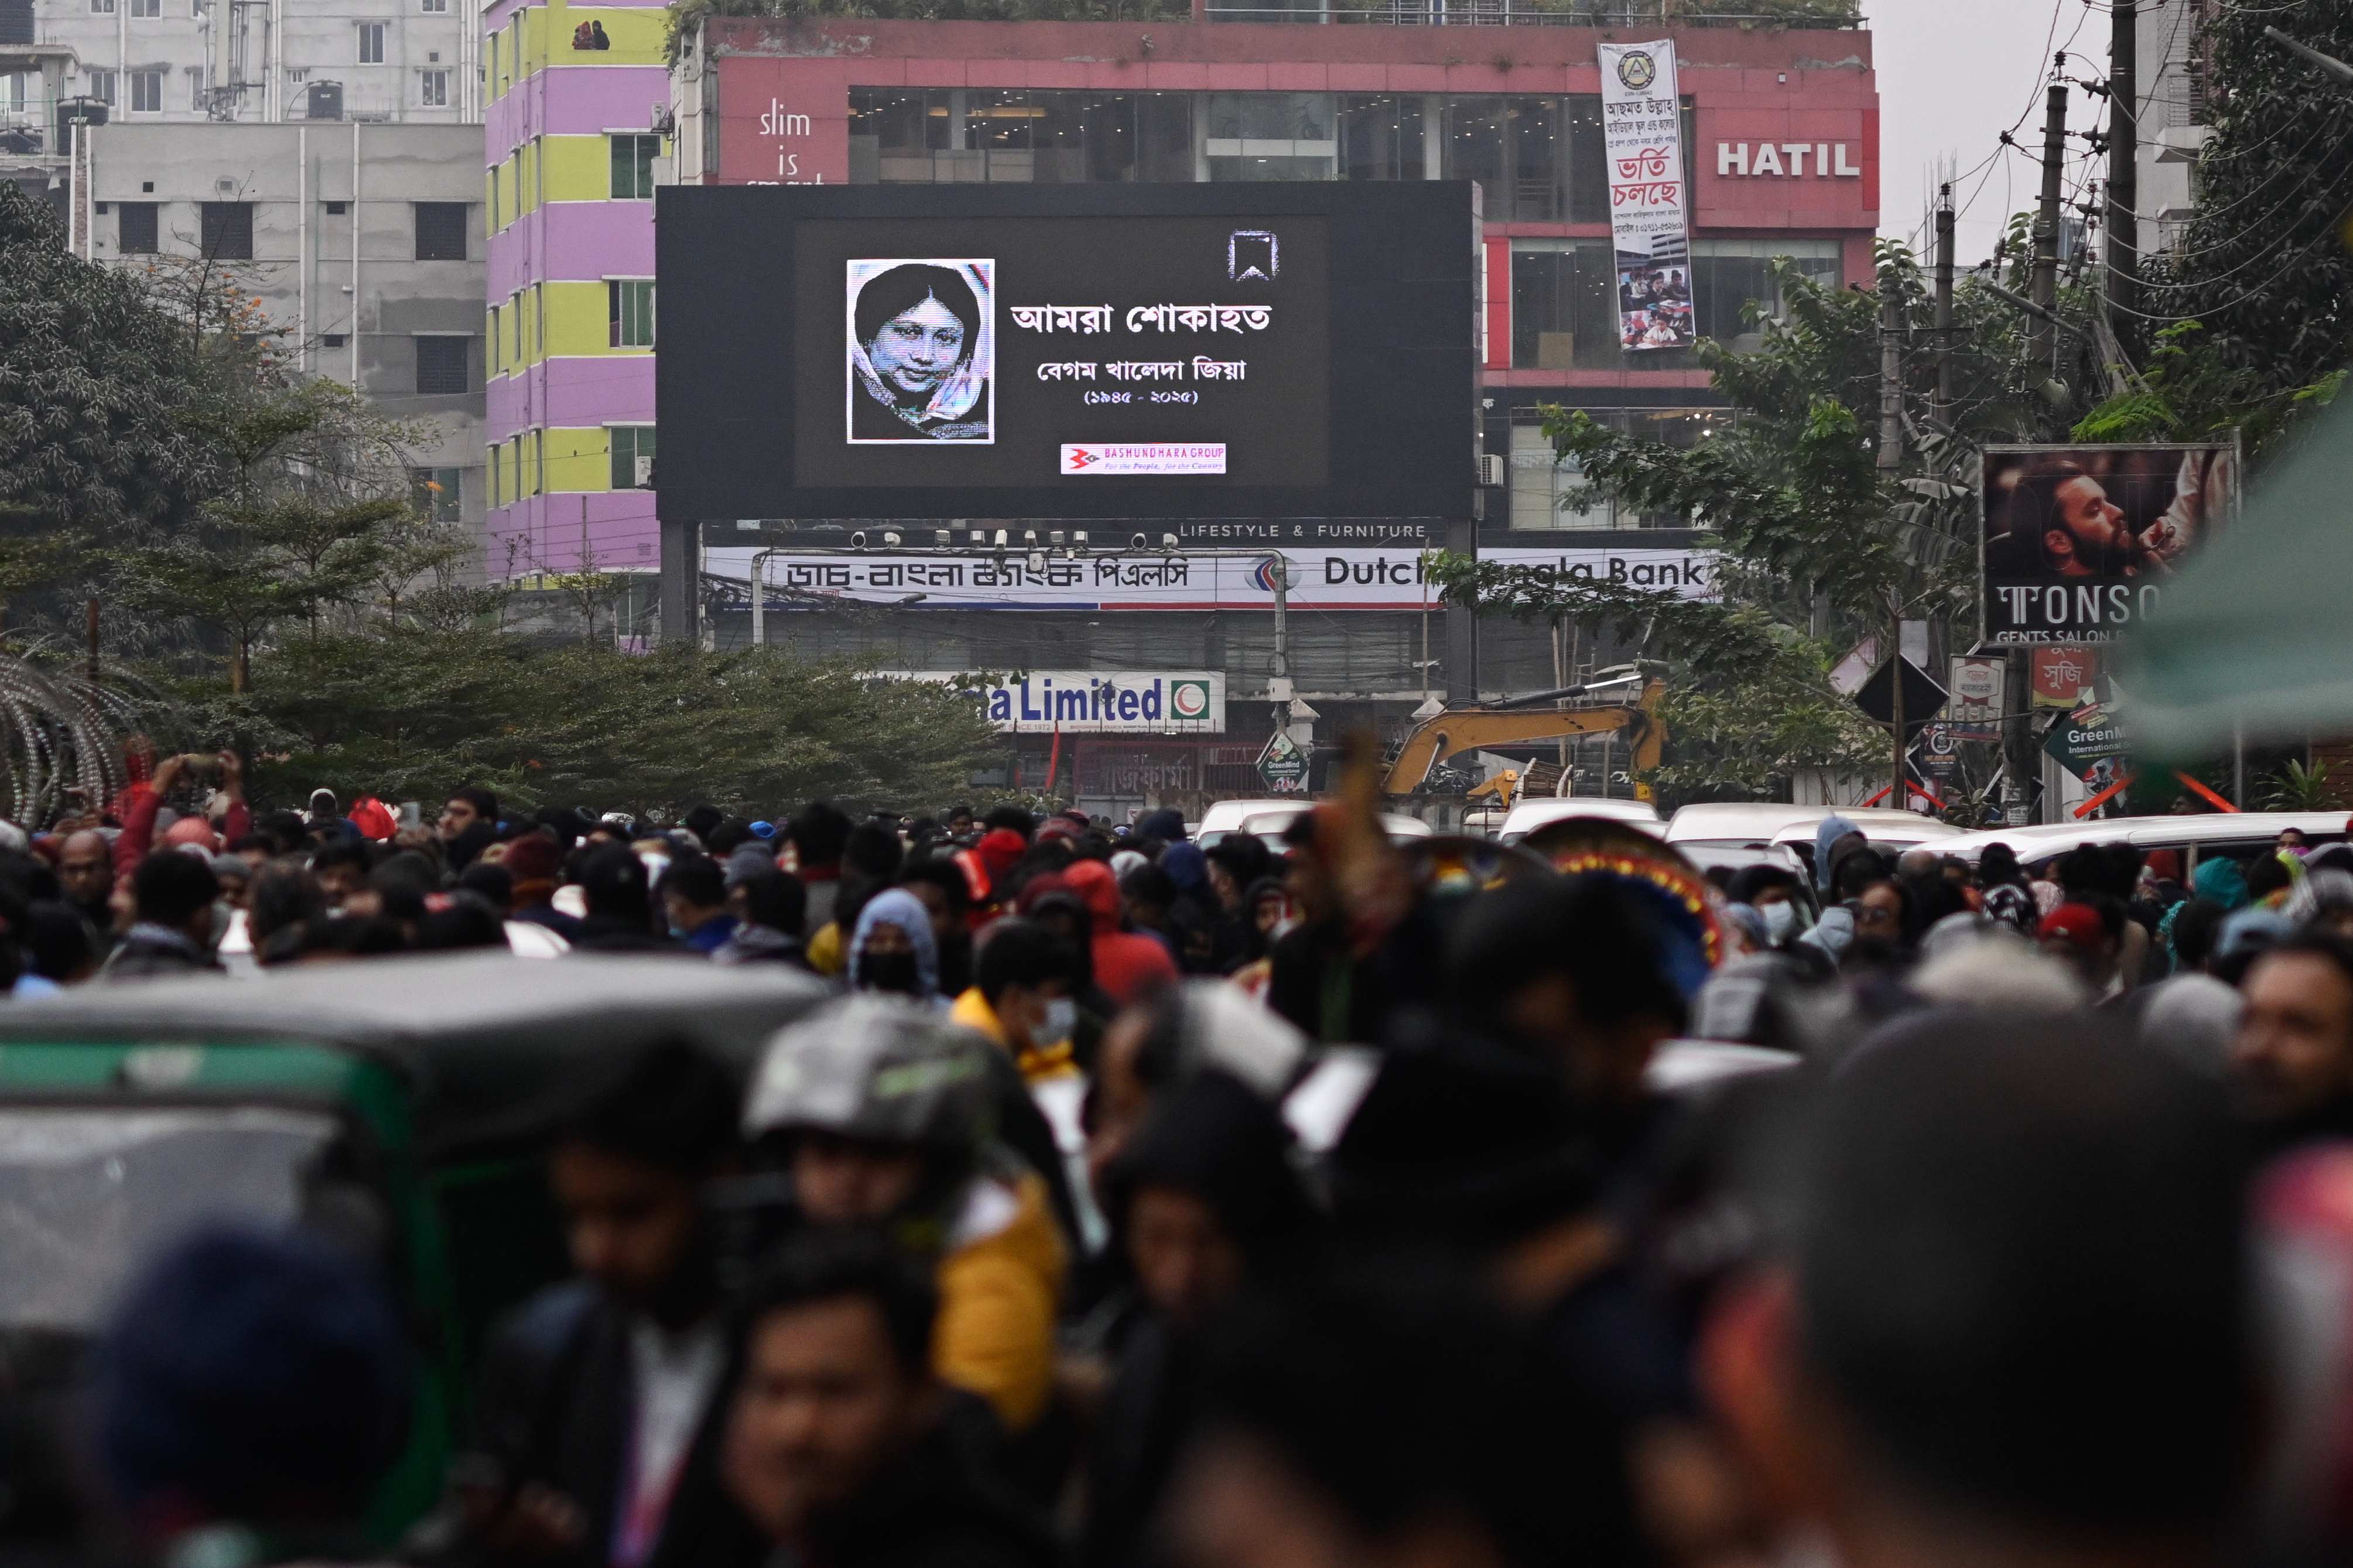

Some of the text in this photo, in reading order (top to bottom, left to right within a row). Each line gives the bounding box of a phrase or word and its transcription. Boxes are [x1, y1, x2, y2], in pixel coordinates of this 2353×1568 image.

[760, 98, 809, 135] slim
[779, 145, 798, 175] is
[1615, 145, 1671, 180] ভর্তি
[1718, 143, 1860, 176] HATIL
[1611, 181, 1681, 207] চলছে
[1010, 303, 1273, 334] আমরা শোকাহত
[1037, 355, 1247, 381] বেগম খালেদা জিয়া
[1150, 391, 1198, 405] ২০২৫)
[1105, 449, 1224, 458] BASHUNDHARA GROUP
[1180, 525, 1425, 537] LIFESTYLE & FURNITURE
[1093, 556, 1189, 587] পিএলসি
[1609, 557, 1705, 586] Bank
[1997, 630, 2050, 642] GENTS
[2056, 630, 2109, 642] SALON
[2042, 660, 2083, 690] সুজি
[1021, 678, 1162, 721] Limited
